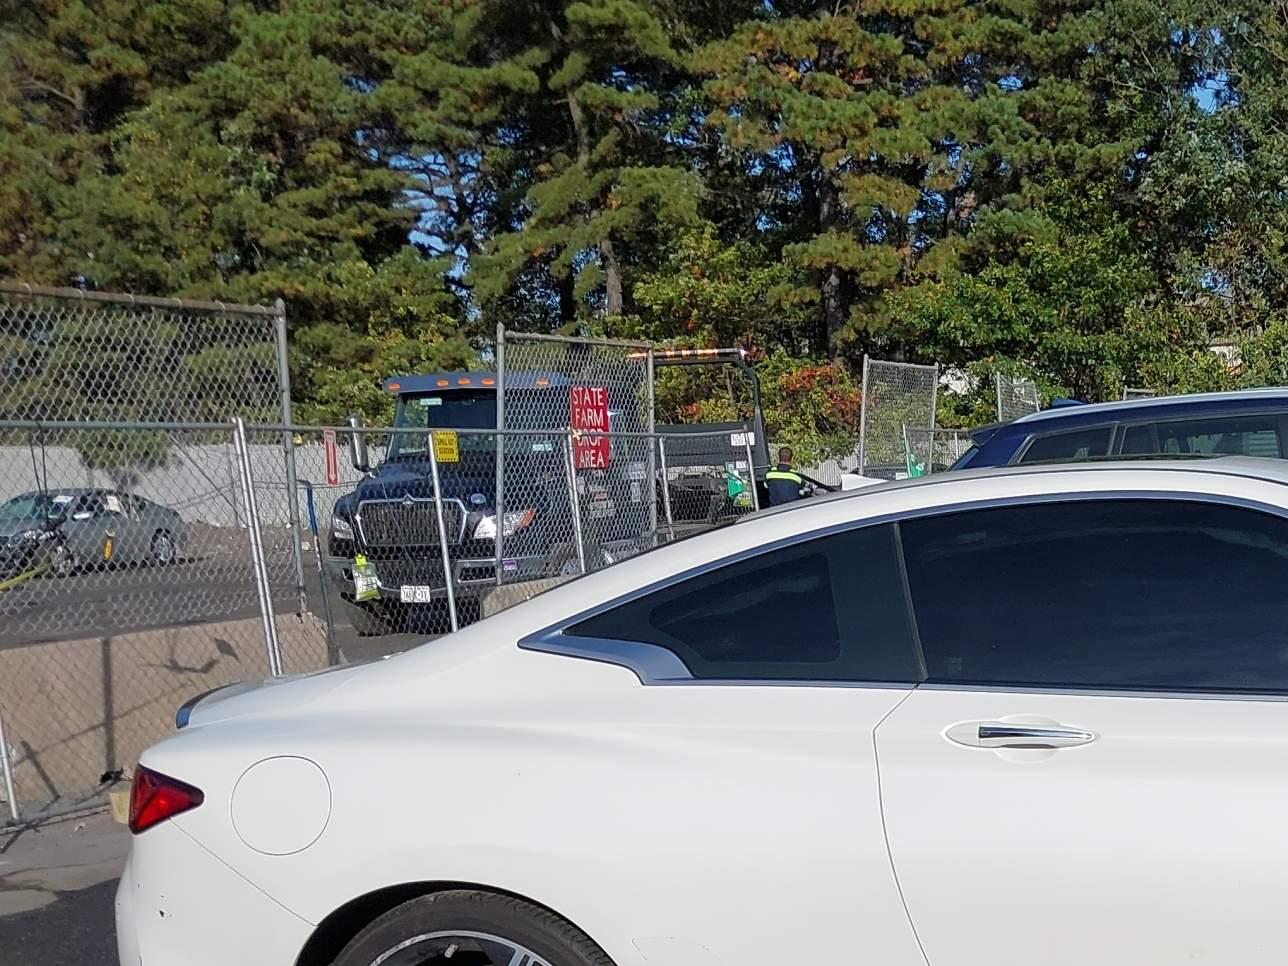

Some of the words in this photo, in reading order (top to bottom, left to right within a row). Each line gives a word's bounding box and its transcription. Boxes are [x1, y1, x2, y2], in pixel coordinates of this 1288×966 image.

[572, 387, 604, 406] STATE
[575, 408, 604, 427] FARM
[577, 428, 605, 447] DROP
[579, 450, 605, 468] AREA
